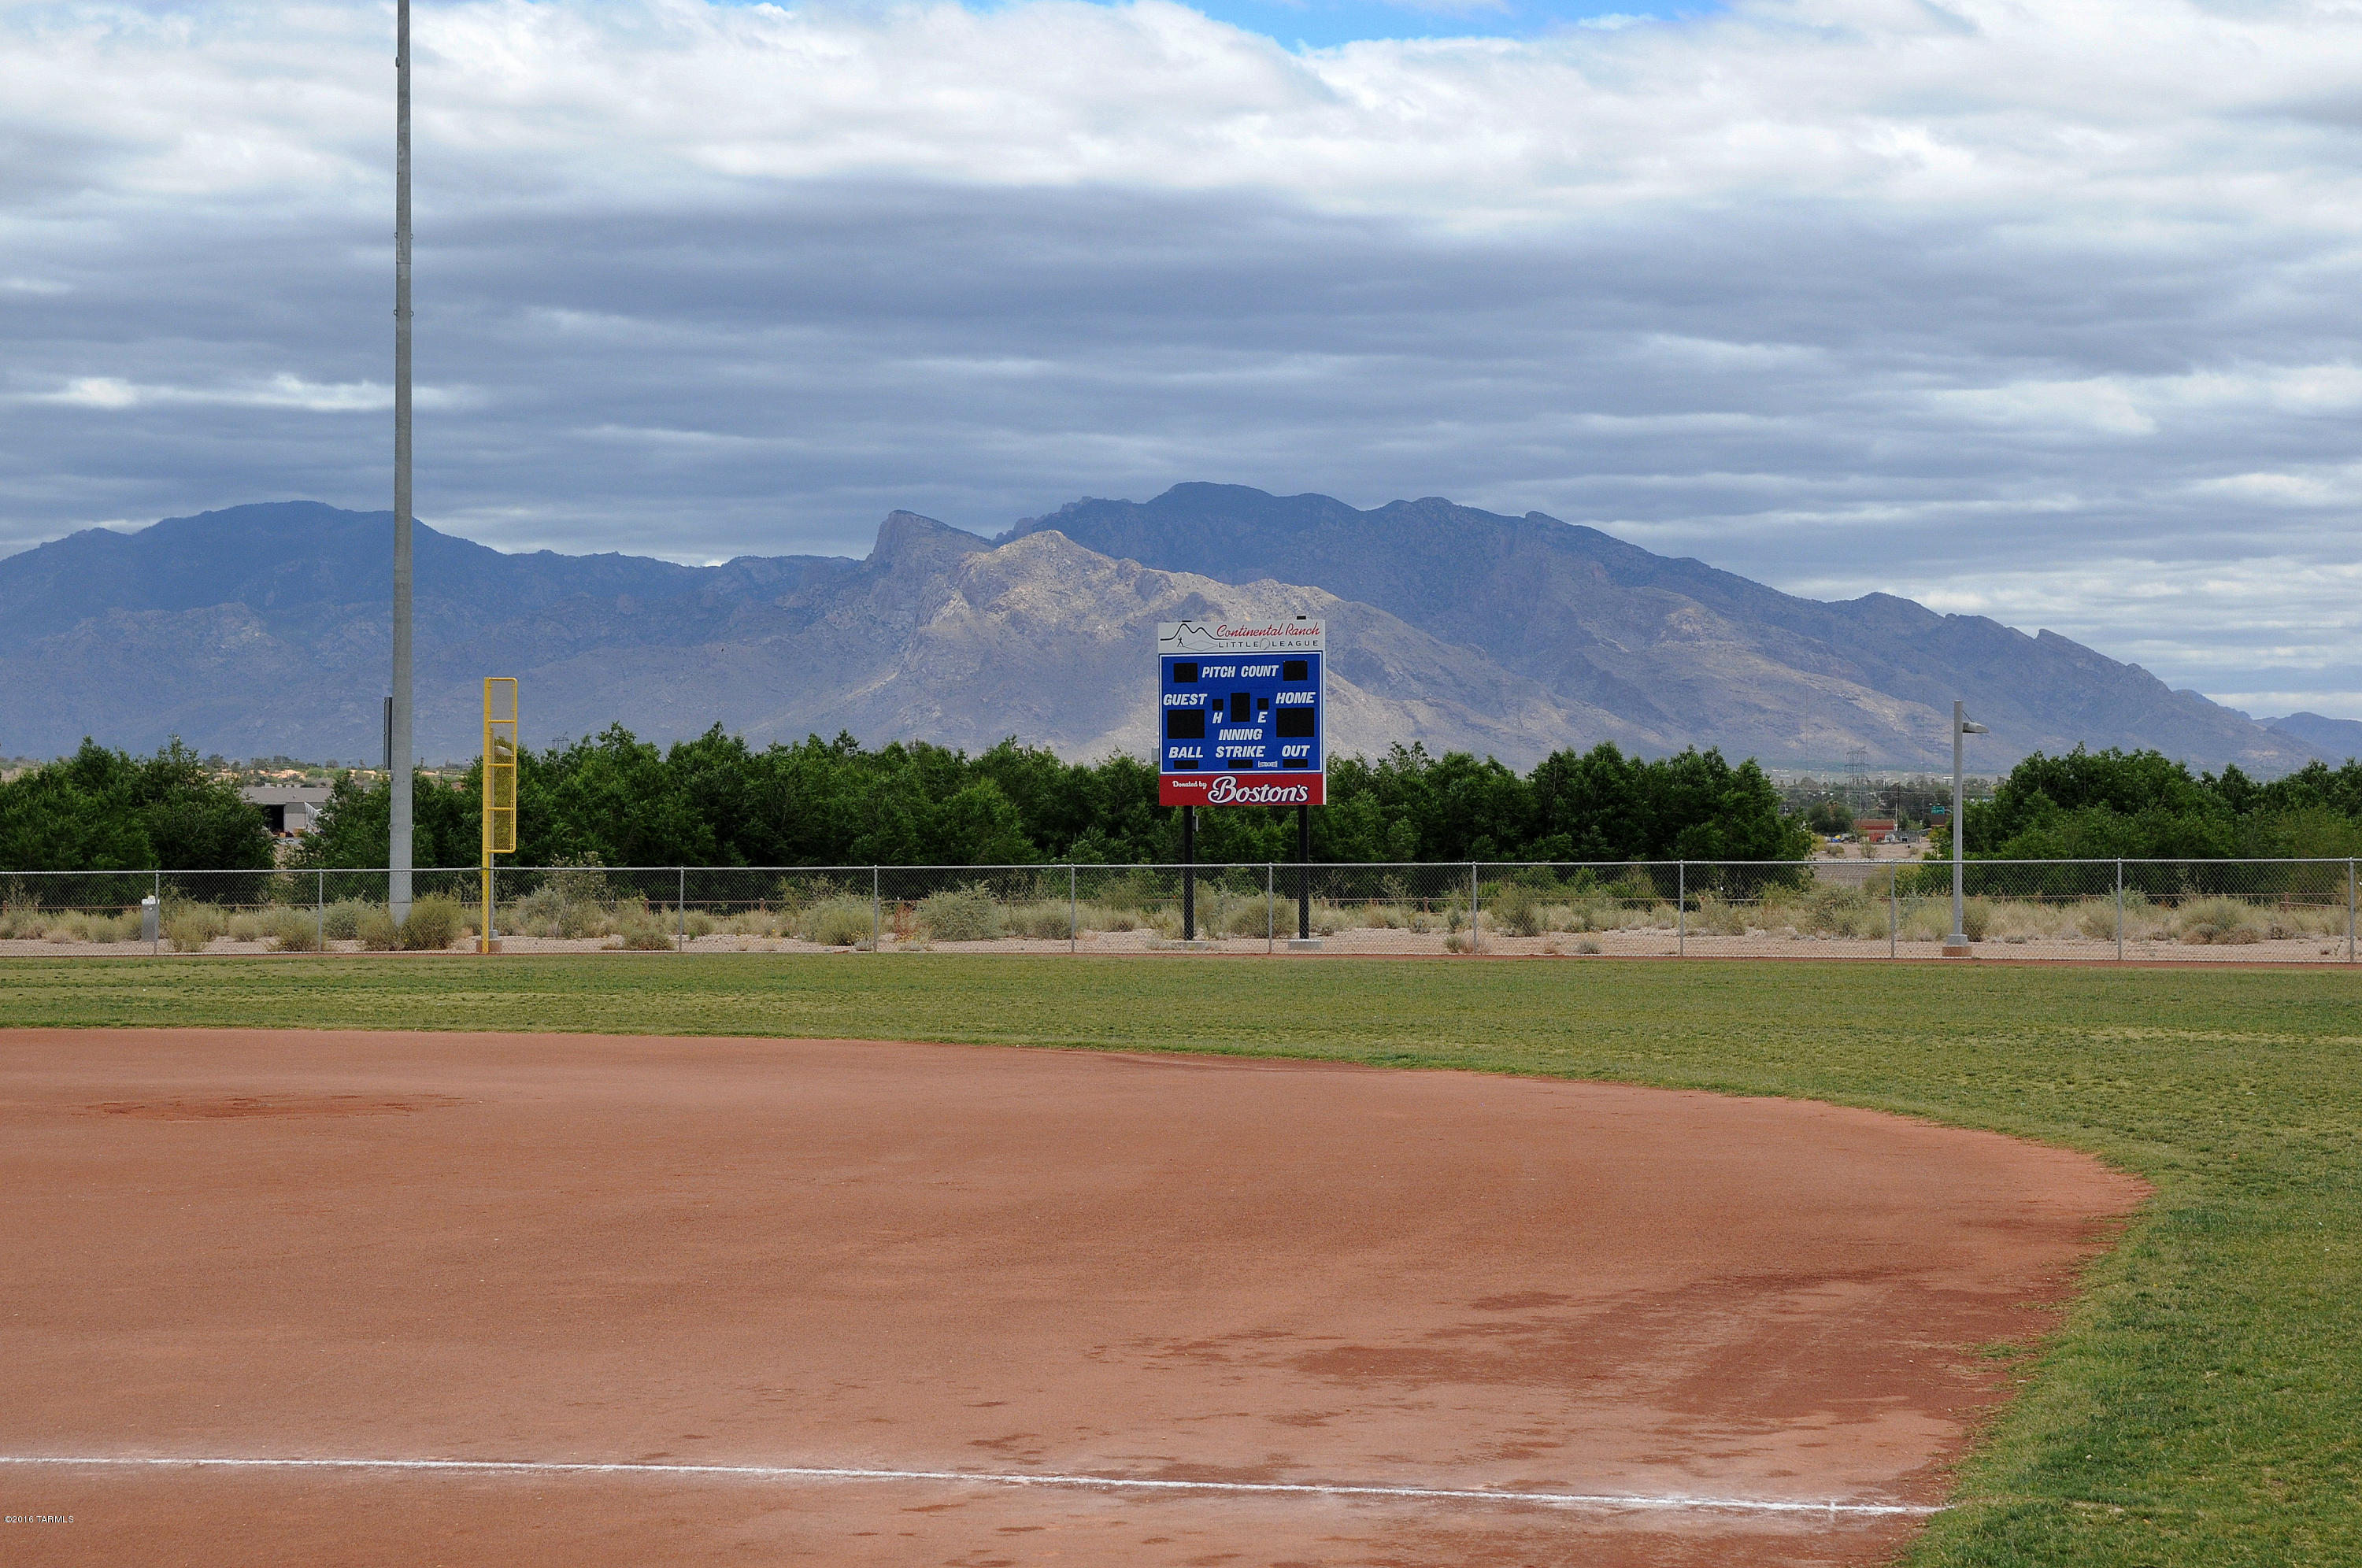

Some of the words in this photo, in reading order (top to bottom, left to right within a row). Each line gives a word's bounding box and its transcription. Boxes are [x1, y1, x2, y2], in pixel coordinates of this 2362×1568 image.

[1216, 623, 1283, 638] Continental
[1285, 622, 1320, 636] Ranch
[1201, 666, 1236, 679] PITCH
[1241, 664, 1279, 678] COUNT
[1163, 693, 1208, 706] GUEST
[1275, 691, 1316, 704] HOME
[1212, 712, 1223, 724] H
[1257, 711, 1268, 723] E
[1218, 728, 1263, 741] INNING
[1168, 746, 1204, 759] BALL
[1215, 745, 1265, 758] STRIKE
[1281, 745, 1310, 757] OUT
[1198, 780, 1208, 790] by
[1207, 775, 1309, 804] Boston's
